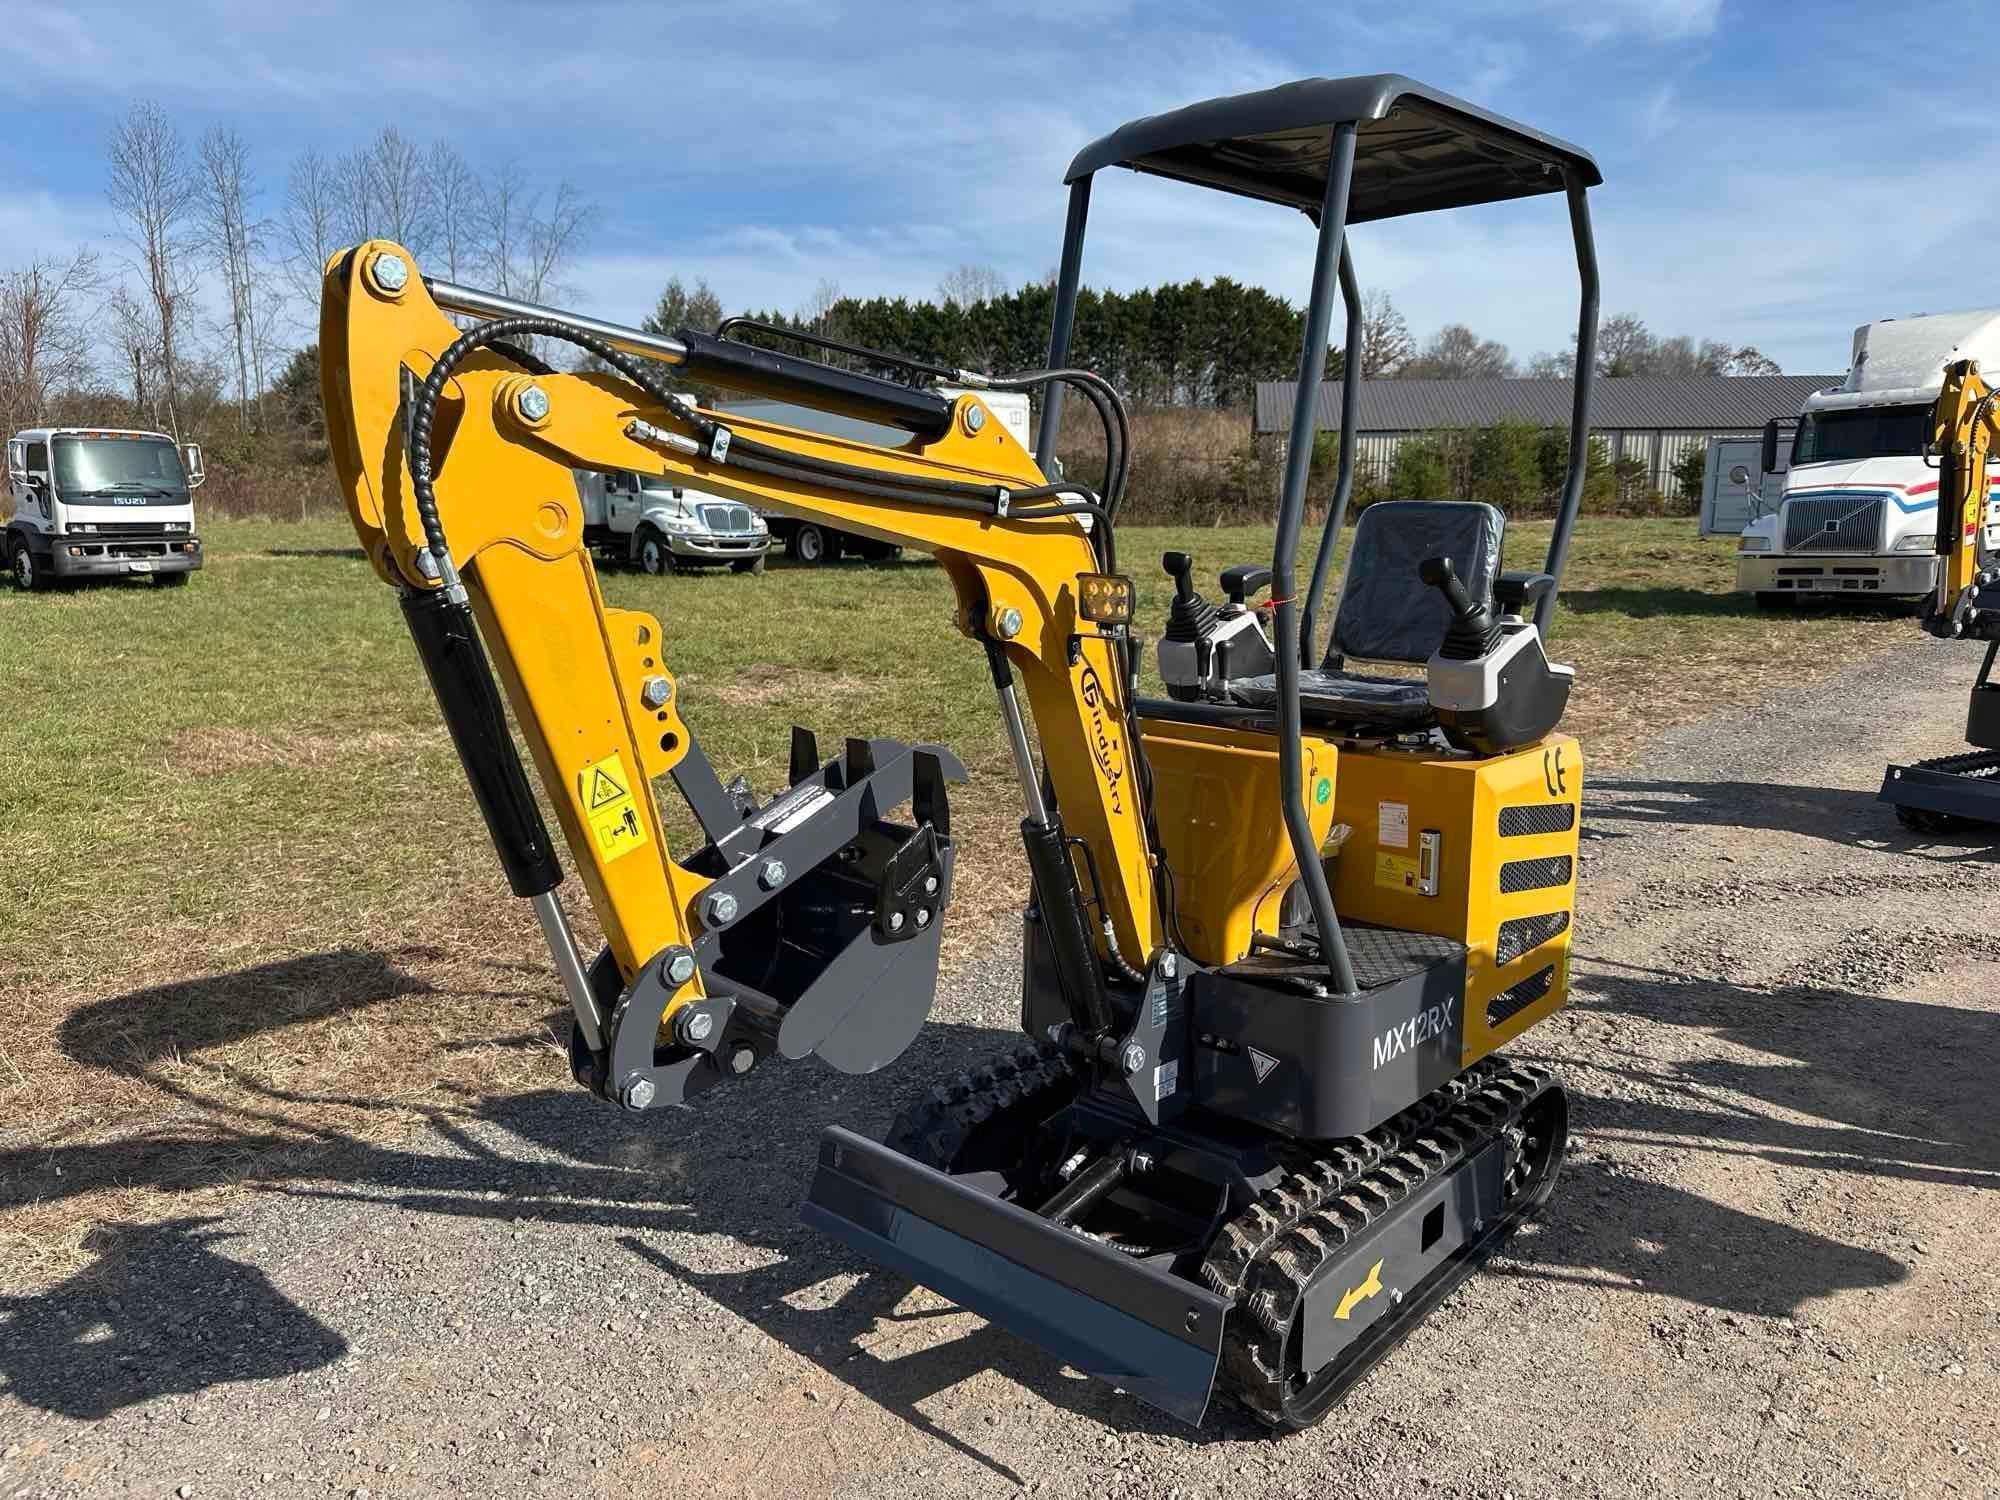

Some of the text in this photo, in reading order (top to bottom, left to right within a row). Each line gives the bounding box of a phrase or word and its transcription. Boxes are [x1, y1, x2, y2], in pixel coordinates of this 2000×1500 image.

[114, 497, 147, 505] ISUZU
[1544, 746, 1566, 797] CE
[1373, 995, 1455, 1070] MX12RX
